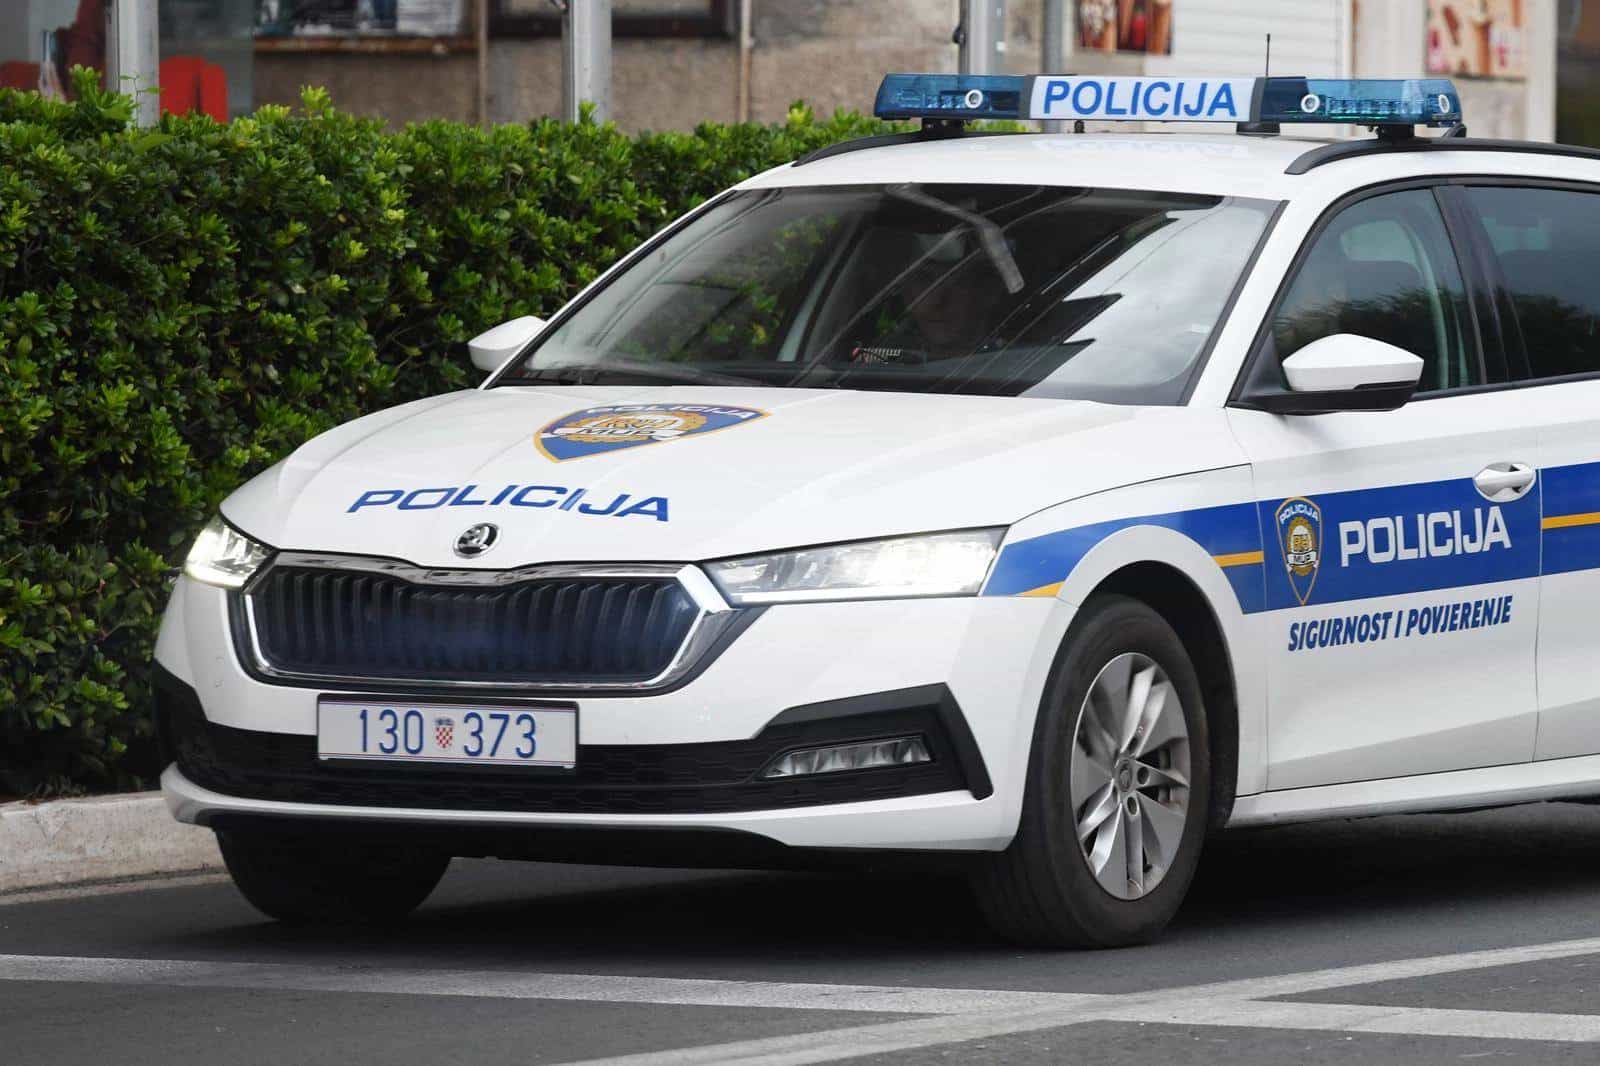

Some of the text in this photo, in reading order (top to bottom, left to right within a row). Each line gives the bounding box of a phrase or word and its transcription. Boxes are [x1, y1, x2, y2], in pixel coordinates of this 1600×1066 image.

[1043, 80, 1237, 117] POLICIJA
[586, 404, 757, 419] POLICIJA
[347, 485, 669, 522] POLICIJA
[1279, 503, 1320, 525] POLICIJA
[1339, 506, 1512, 567] POLICIJA
[1288, 595, 1513, 651] SIGURNOST I POVJERENJE
[359, 709, 536, 758] 130 373
